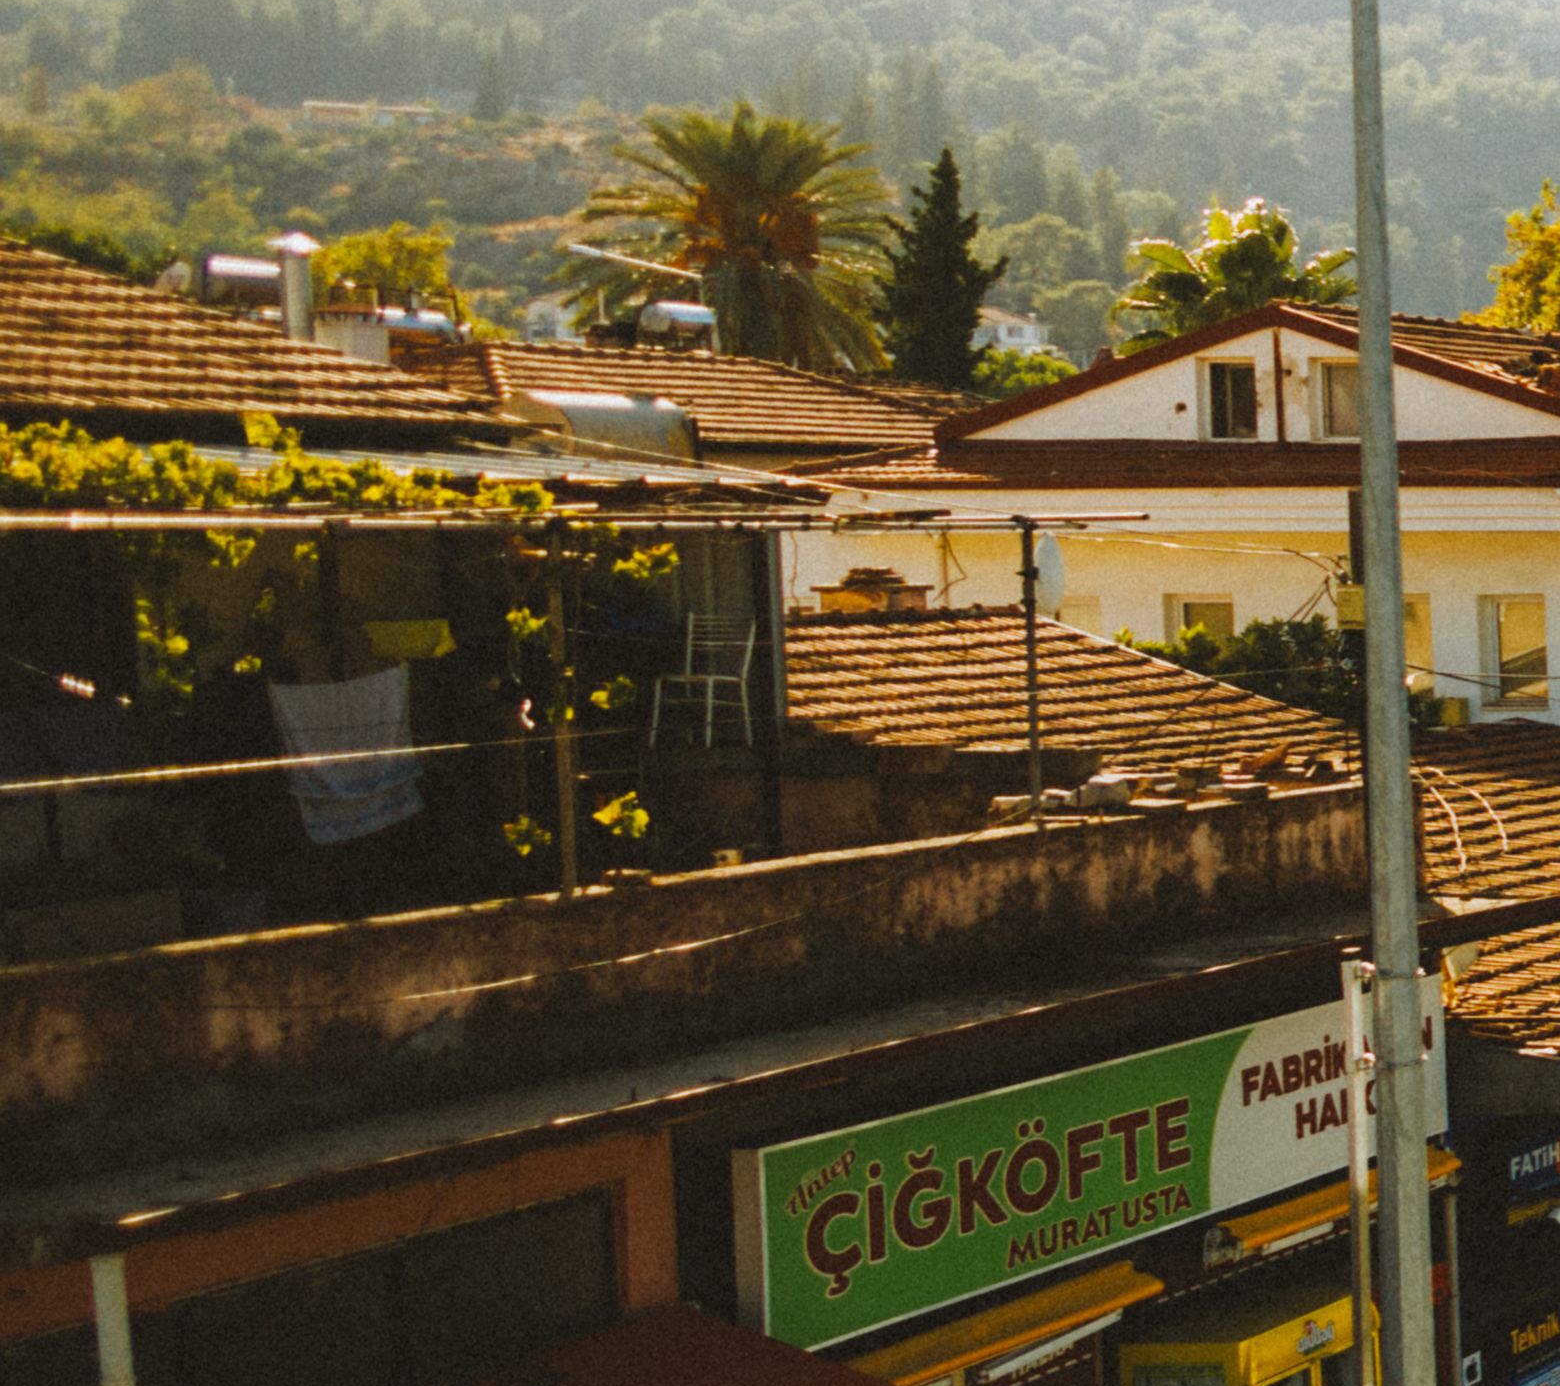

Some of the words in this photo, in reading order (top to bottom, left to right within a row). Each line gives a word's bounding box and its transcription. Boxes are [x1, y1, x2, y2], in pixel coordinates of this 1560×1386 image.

[806, 1095, 1192, 1299] ÇİĞKÖFTE
[1007, 1205, 1118, 1271] MURAT
[1120, 1183, 1192, 1230] USTA
[1510, 1311, 1560, 1355] Teknik
